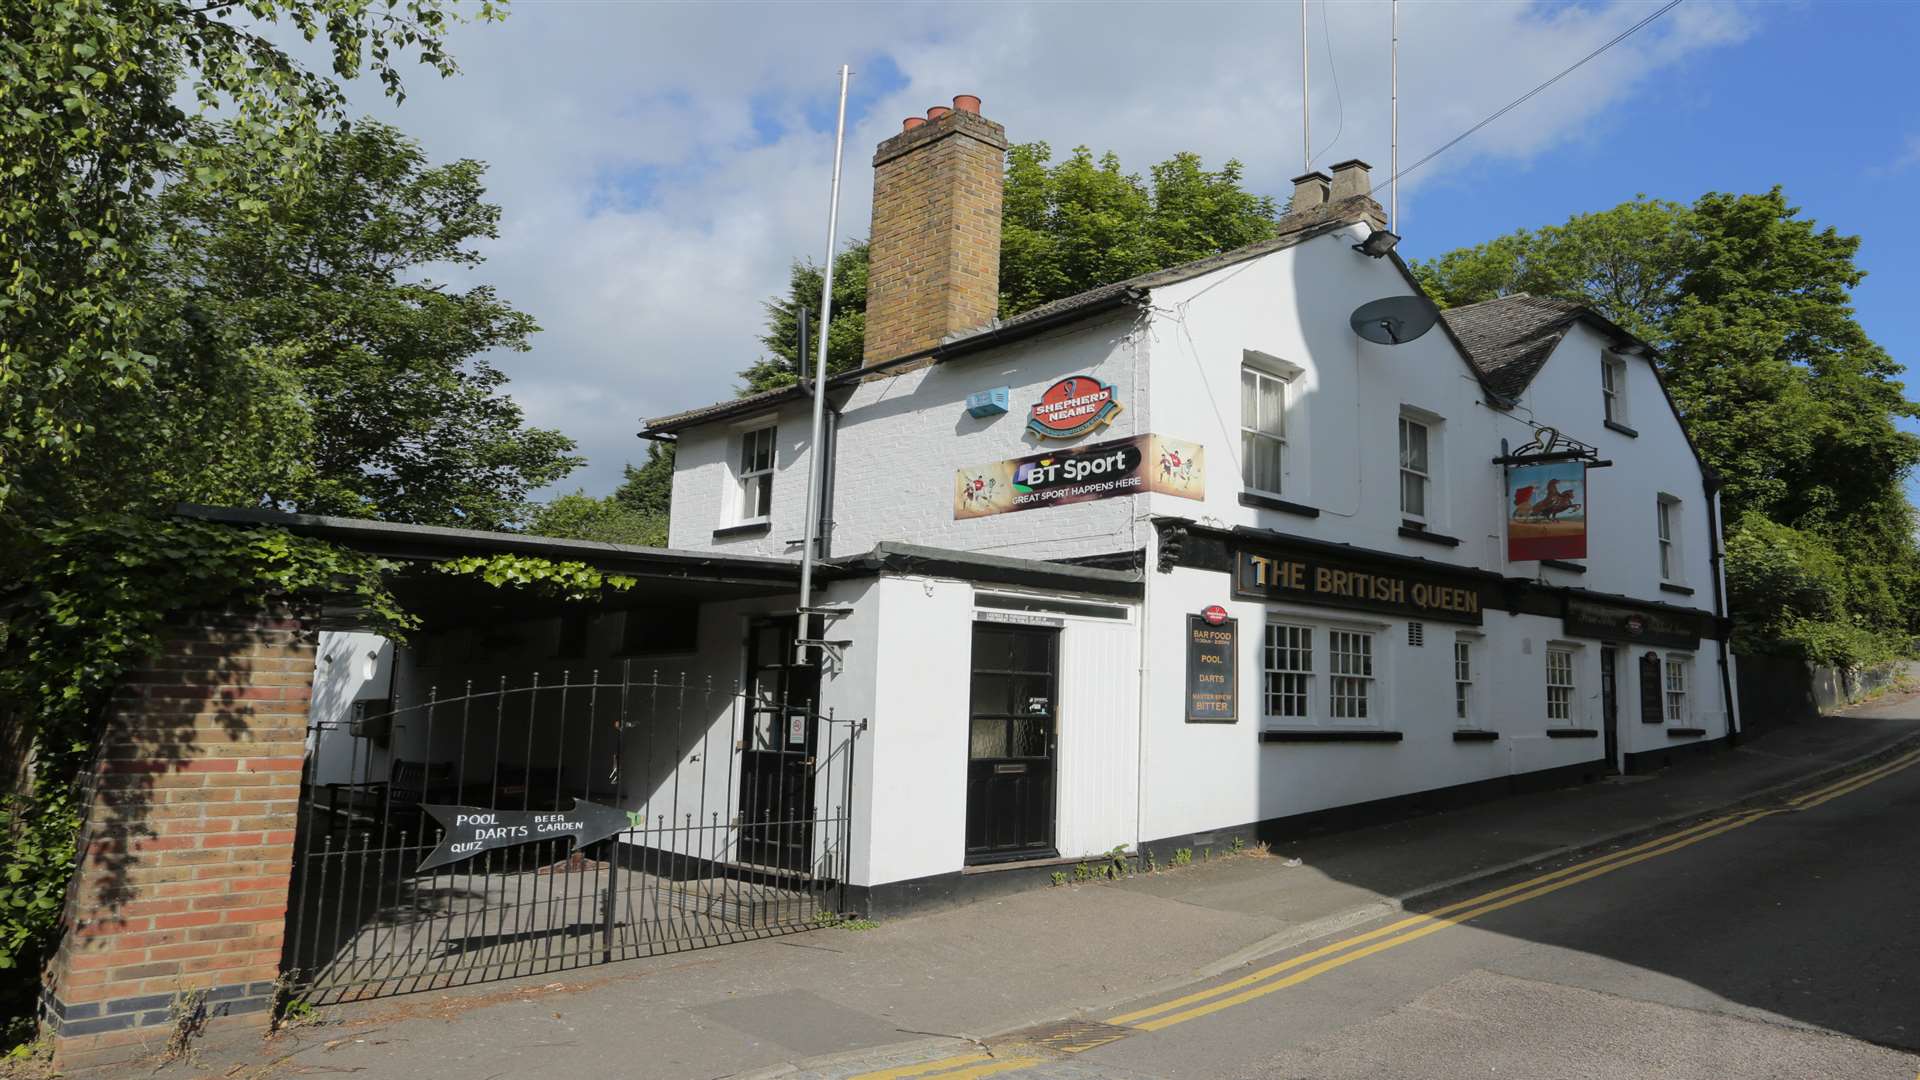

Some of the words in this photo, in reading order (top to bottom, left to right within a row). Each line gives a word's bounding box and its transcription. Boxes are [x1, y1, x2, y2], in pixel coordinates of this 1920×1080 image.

[1036, 391, 1108, 415] SHEPHERD
[1049, 404, 1095, 421] NEAME
[1027, 464, 1060, 485] BT
[1063, 451, 1126, 480] Sport
[1012, 491, 1040, 504] GREAT
[1041, 487, 1070, 501] SPORT
[1071, 482, 1113, 497] HAPPENS
[1115, 477, 1142, 488] HERE
[1251, 556, 1306, 590] THE
[1316, 567, 1405, 603] BRITISH
[1411, 583, 1478, 613] QUEEN
[1193, 630, 1209, 639] BAR
[1210, 631, 1231, 640] FOOD
[1201, 655, 1223, 664] POOL
[1199, 674, 1225, 683] DARTS
[1195, 702, 1228, 711] BITTER
[456, 814, 500, 826] POOL
[534, 815, 565, 823] BEER
[475, 825, 528, 840] DARTS
[537, 822, 583, 832] GARDEN
[451, 841, 484, 853] QUIZ
